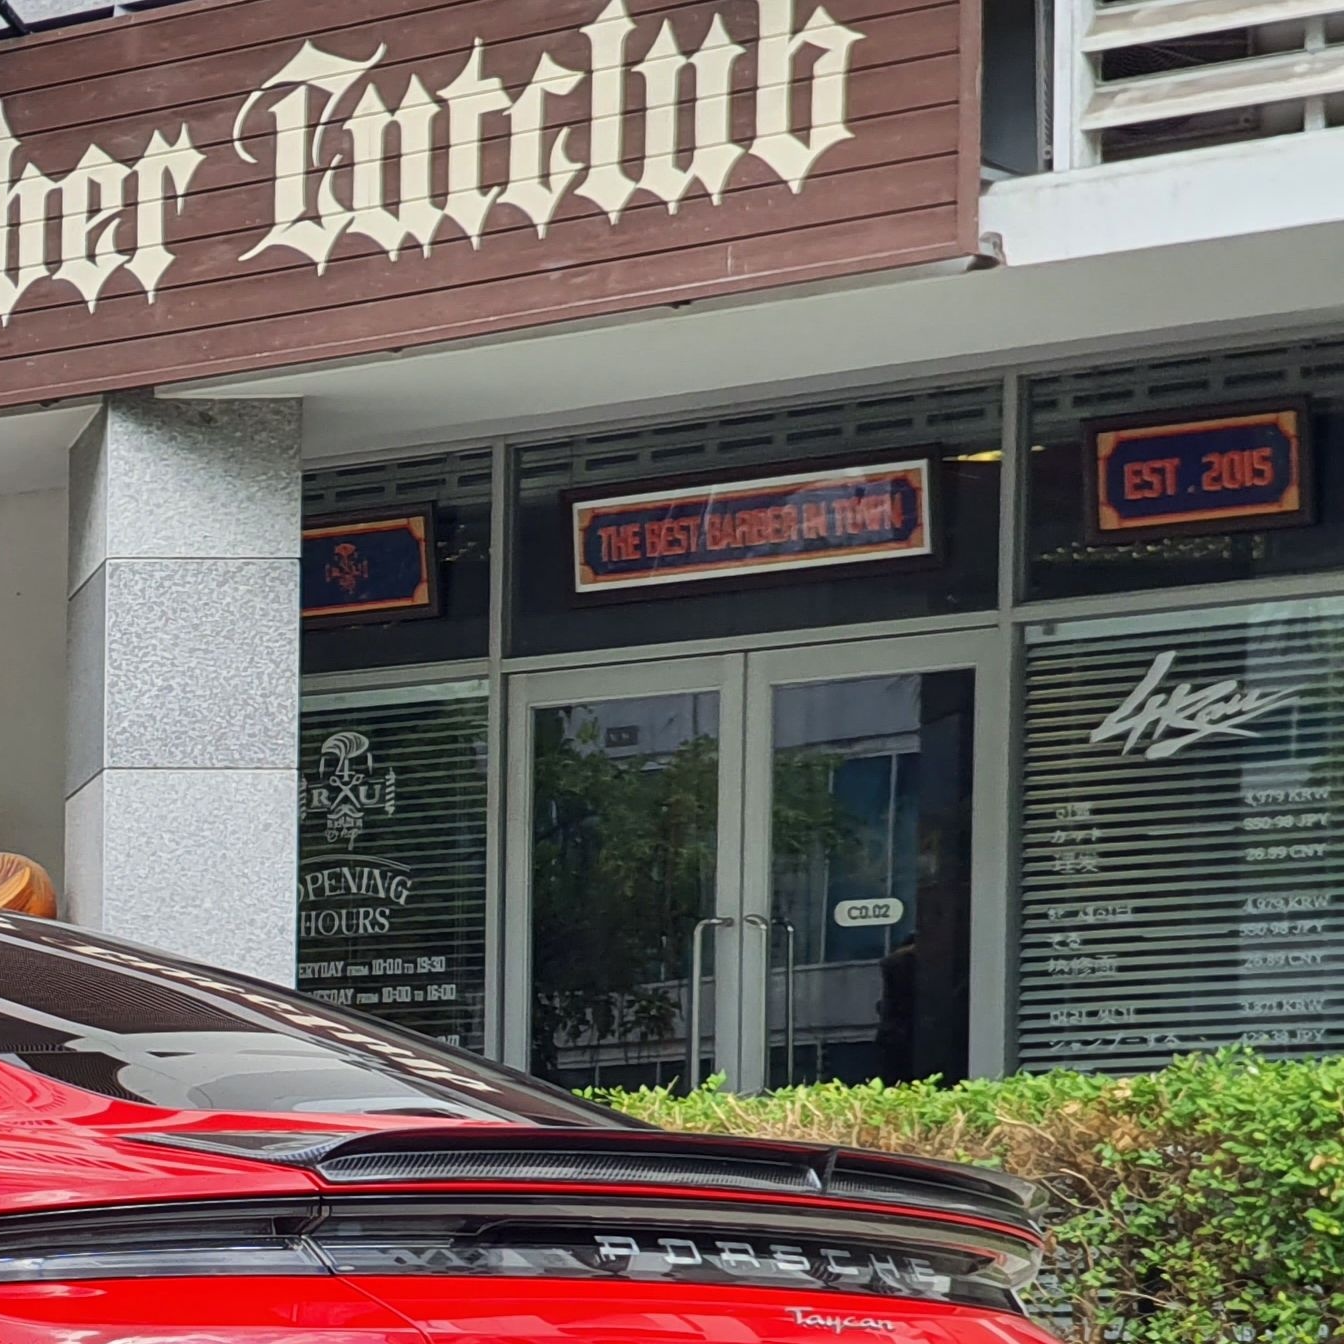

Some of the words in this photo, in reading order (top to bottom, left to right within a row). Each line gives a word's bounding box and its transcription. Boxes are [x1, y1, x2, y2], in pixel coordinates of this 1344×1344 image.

[1201, 447, 1275, 492] 2015
[598, 522, 642, 562] THE
[644, 516, 702, 558] BEST
[705, 506, 799, 551] BARBER
[801, 500, 828, 539] IN
[831, 492, 904, 536] TOWN
[1296, 812, 1330, 828] JPY
[847, 903, 891, 920] C0.02
[1288, 894, 1330, 910] KRW
[300, 907, 390, 937] HOURS
[1292, 919, 1327, 935] JPY
[371, 958, 403, 976] 10:00
[416, 956, 446, 974] 19:30
[1289, 950, 1326, 966] CNY
[381, 986, 412, 1003] 10:00
[426, 984, 457, 1001] 16:00
[594, 1234, 936, 1283] PORSCHE
[784, 1307, 897, 1334] Taycan
